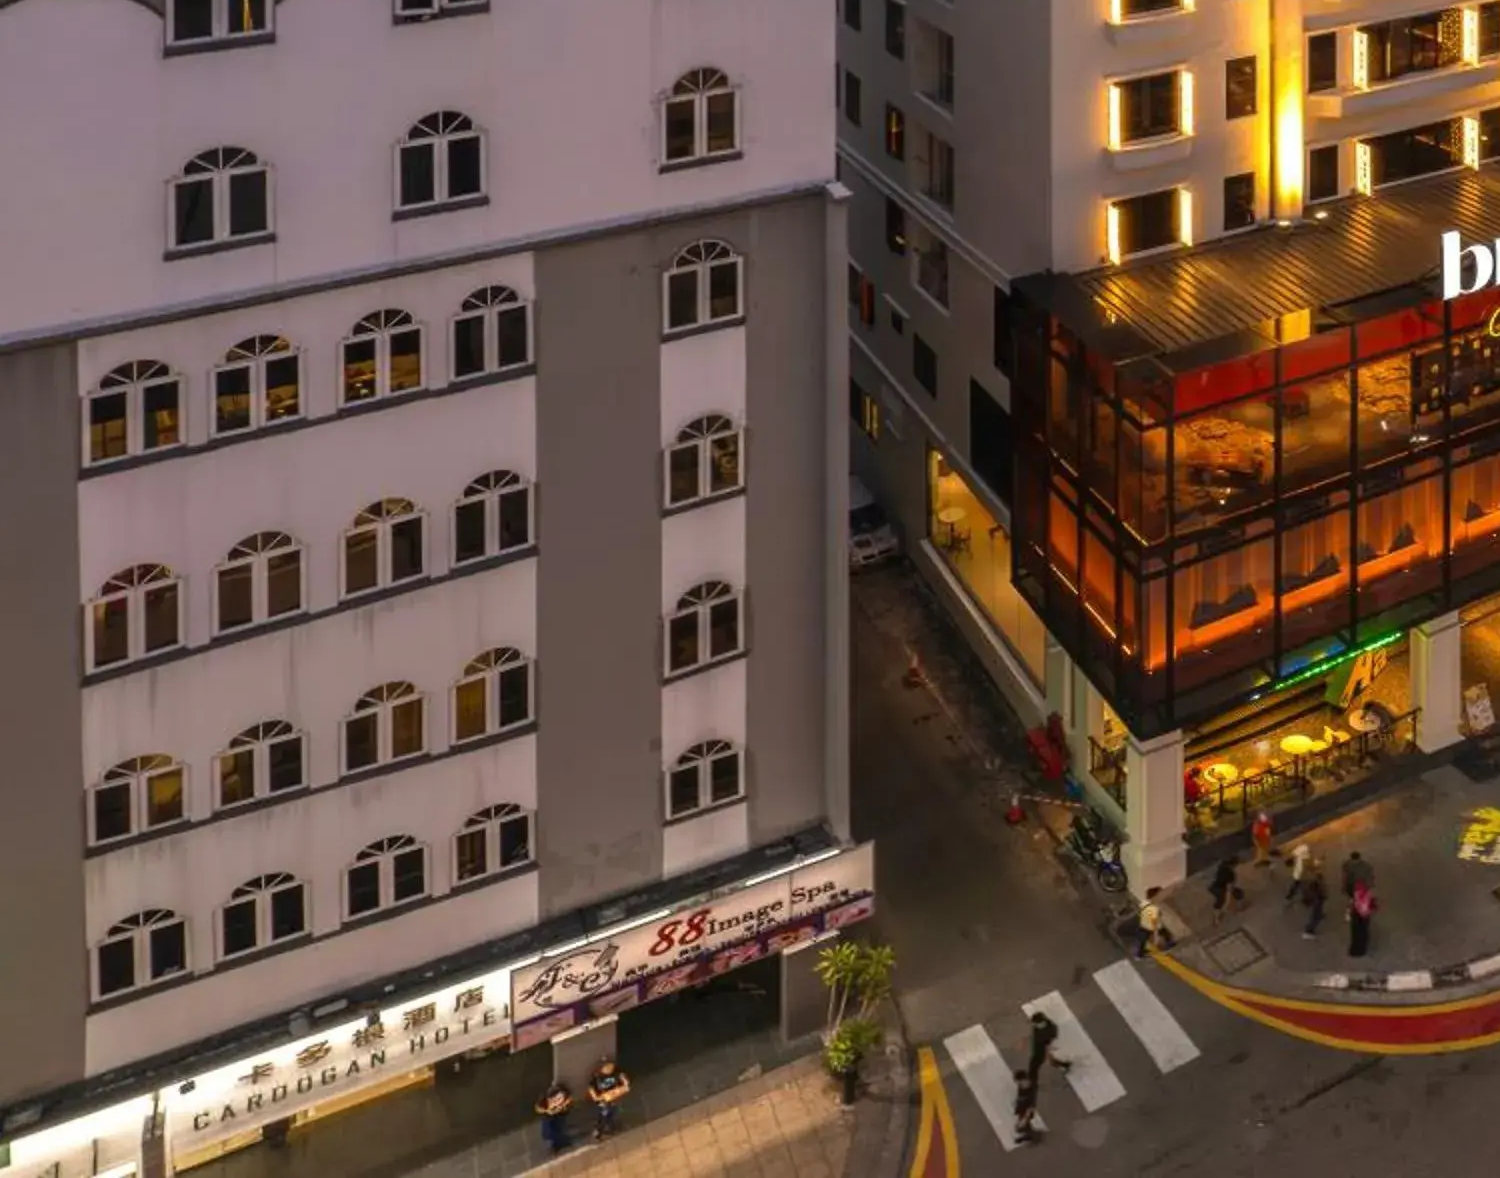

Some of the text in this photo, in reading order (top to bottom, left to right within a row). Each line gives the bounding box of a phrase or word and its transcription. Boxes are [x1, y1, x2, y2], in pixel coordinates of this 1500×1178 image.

[648, 909, 712, 958] 88
[706, 898, 786, 937] Image
[790, 879, 838, 910] Spa
[192, 1048, 387, 1133] CARDOGAN
